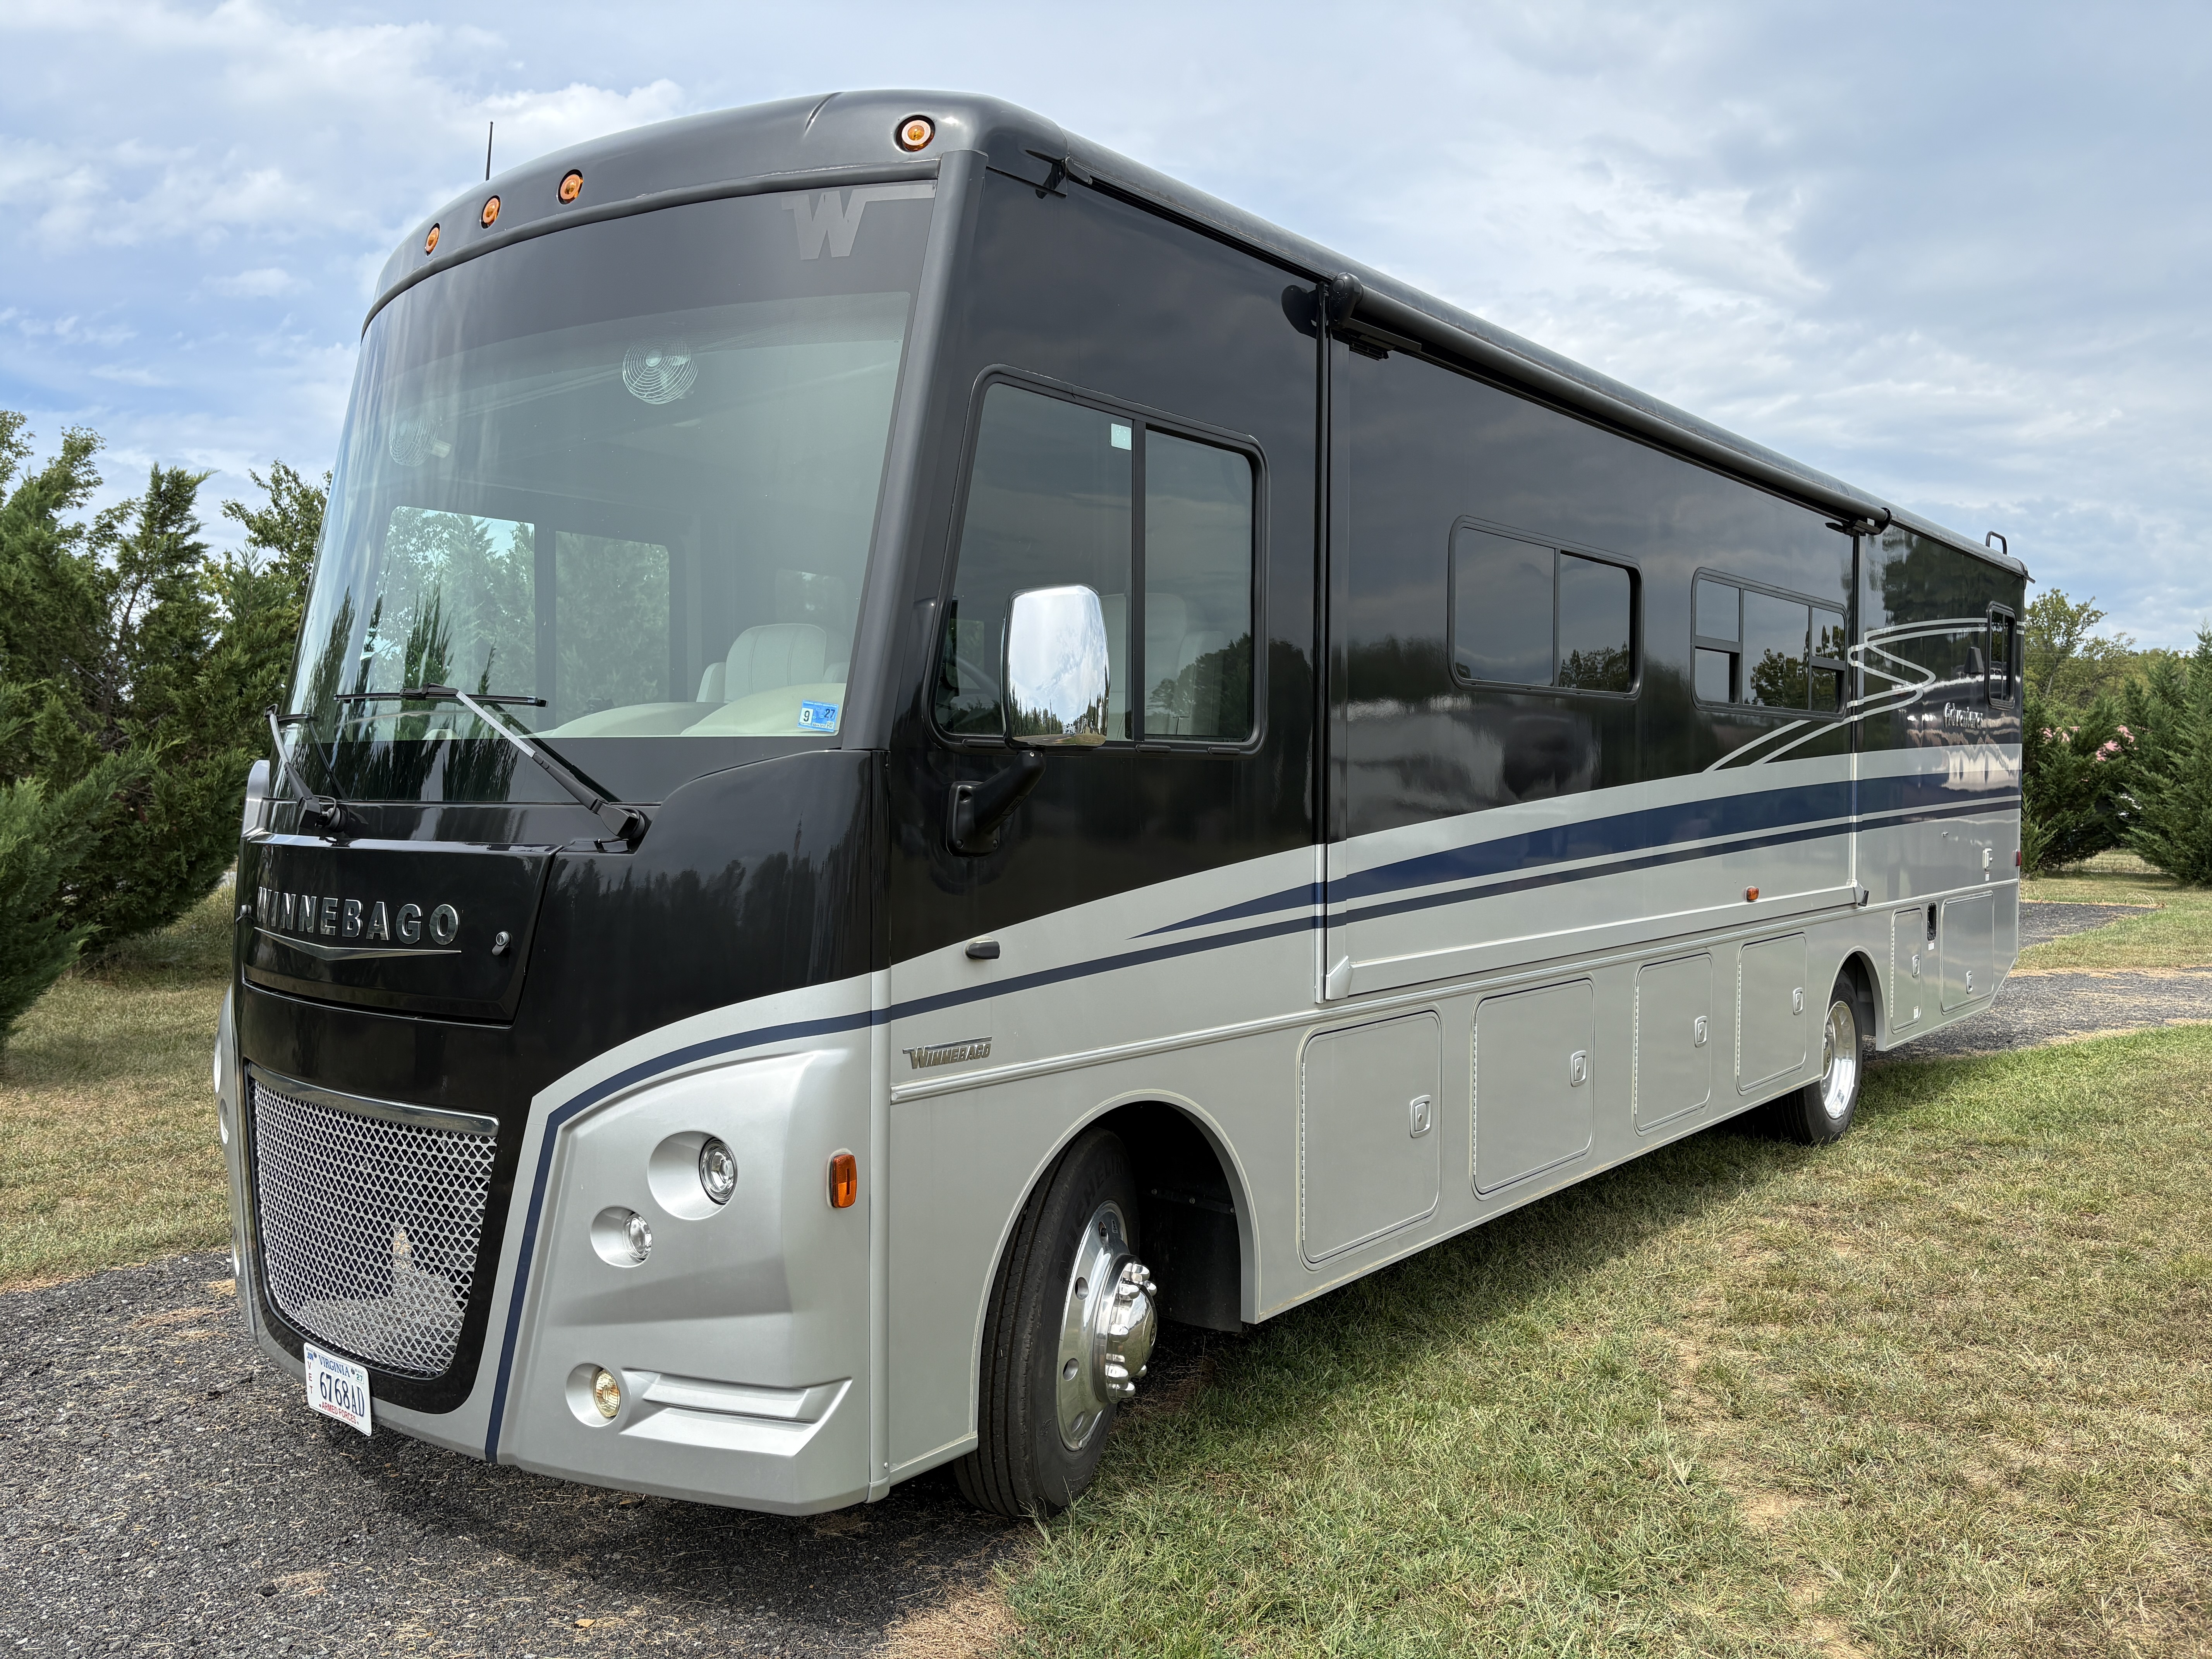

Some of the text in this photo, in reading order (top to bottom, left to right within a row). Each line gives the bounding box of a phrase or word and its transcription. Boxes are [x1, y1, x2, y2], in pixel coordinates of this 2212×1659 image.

[804, 708, 835, 722] 9 27
[256, 886, 460, 945] WINNEBAGO
[903, 1036, 992, 1069] WINNEBAGO
[1056, 1156, 1123, 1284] MICHELIN
[318, 1354, 350, 1377] VIRGINIA
[356, 1374, 362, 1382] 27
[320, 1371, 365, 1417] 6768AD
[322, 1401, 357, 1423] ARMED FORCES
